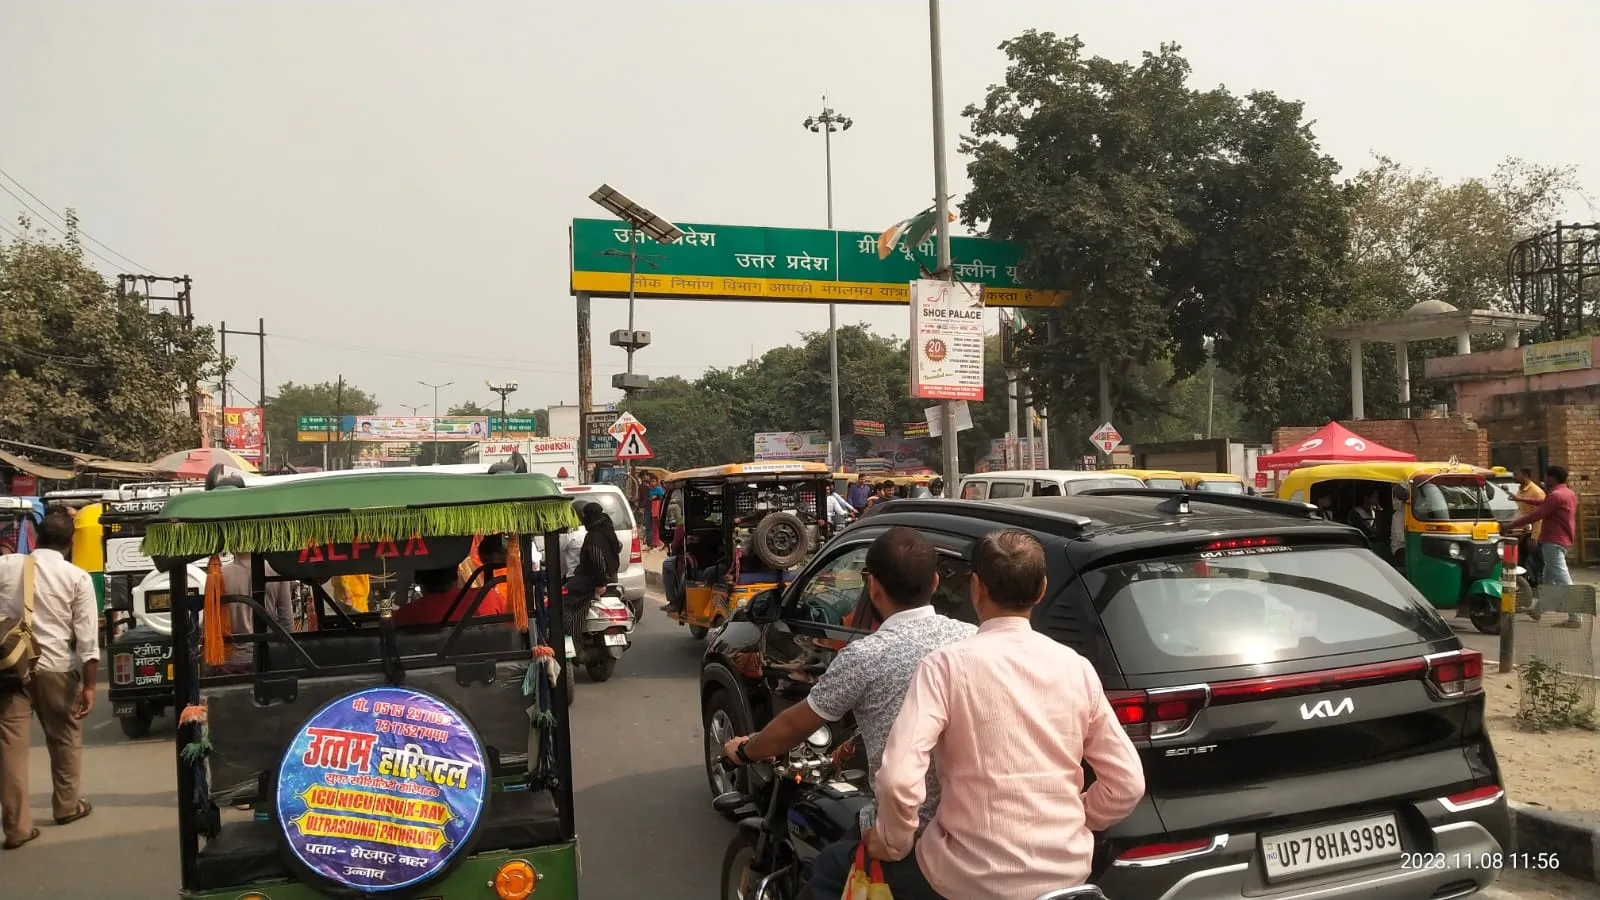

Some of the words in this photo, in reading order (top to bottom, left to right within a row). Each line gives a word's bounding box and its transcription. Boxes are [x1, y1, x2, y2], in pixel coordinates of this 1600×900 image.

[613, 228, 660, 244] उत्त
[734, 254, 776, 269] उत्तर
[786, 251, 829, 271] प्रदेश
[953, 259, 996, 278] क्लीन
[723, 279, 762, 292] विभाग
[769, 281, 812, 293] आपकी
[923, 309, 947, 318] SHOE
[949, 310, 982, 319] PALACE
[298, 532, 430, 563] ALFAA
[373, 701, 405, 718] 0515
[1300, 697, 1355, 720] KIA
[303, 727, 379, 773] उत्तम
[1165, 744, 1218, 757] SONET
[310, 789, 336, 806] ICU
[337, 792, 373, 812] NICU
[405, 801, 446, 821] X-RAY
[305, 815, 376, 838] ULTRASOUND
[379, 823, 440, 846] PATHOLOGY
[350, 845, 396, 864] शेखपुर
[1277, 823, 1398, 868] UP78HA9989
[342, 866, 385, 880] उन्नाव
